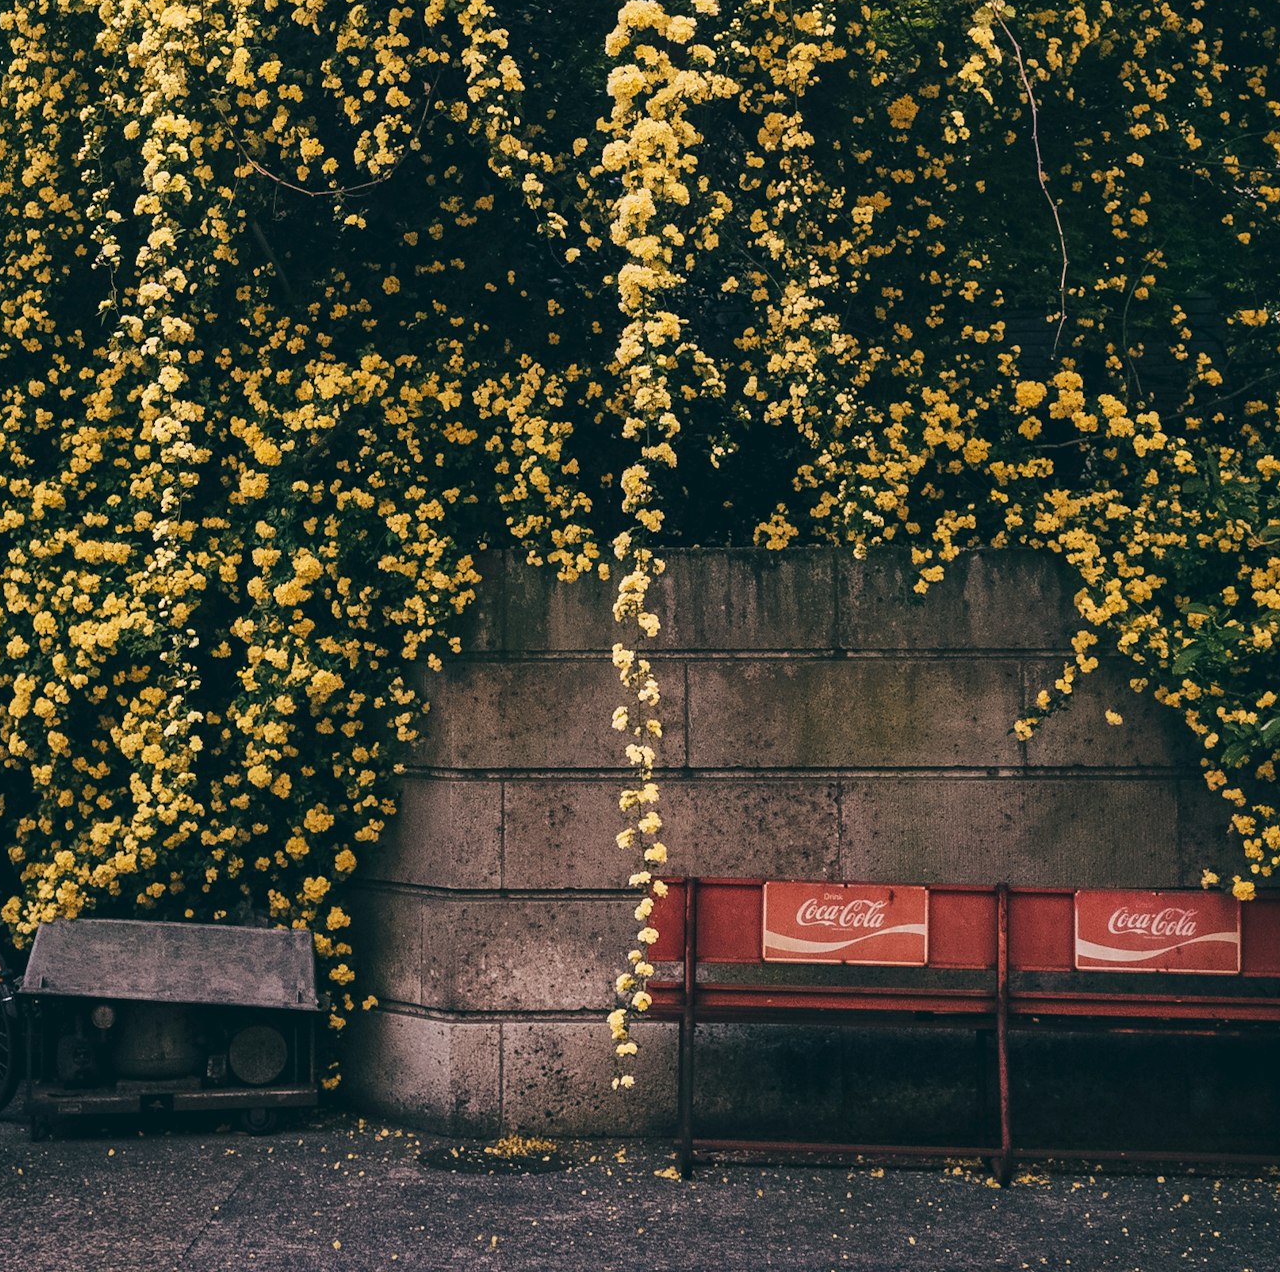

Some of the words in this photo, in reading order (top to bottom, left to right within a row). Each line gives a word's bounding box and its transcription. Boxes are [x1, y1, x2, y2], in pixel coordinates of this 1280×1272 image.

[823, 892, 844, 901] Drink
[796, 898, 888, 928] Coca-Cola
[1107, 906, 1199, 936] Coca-Cola
